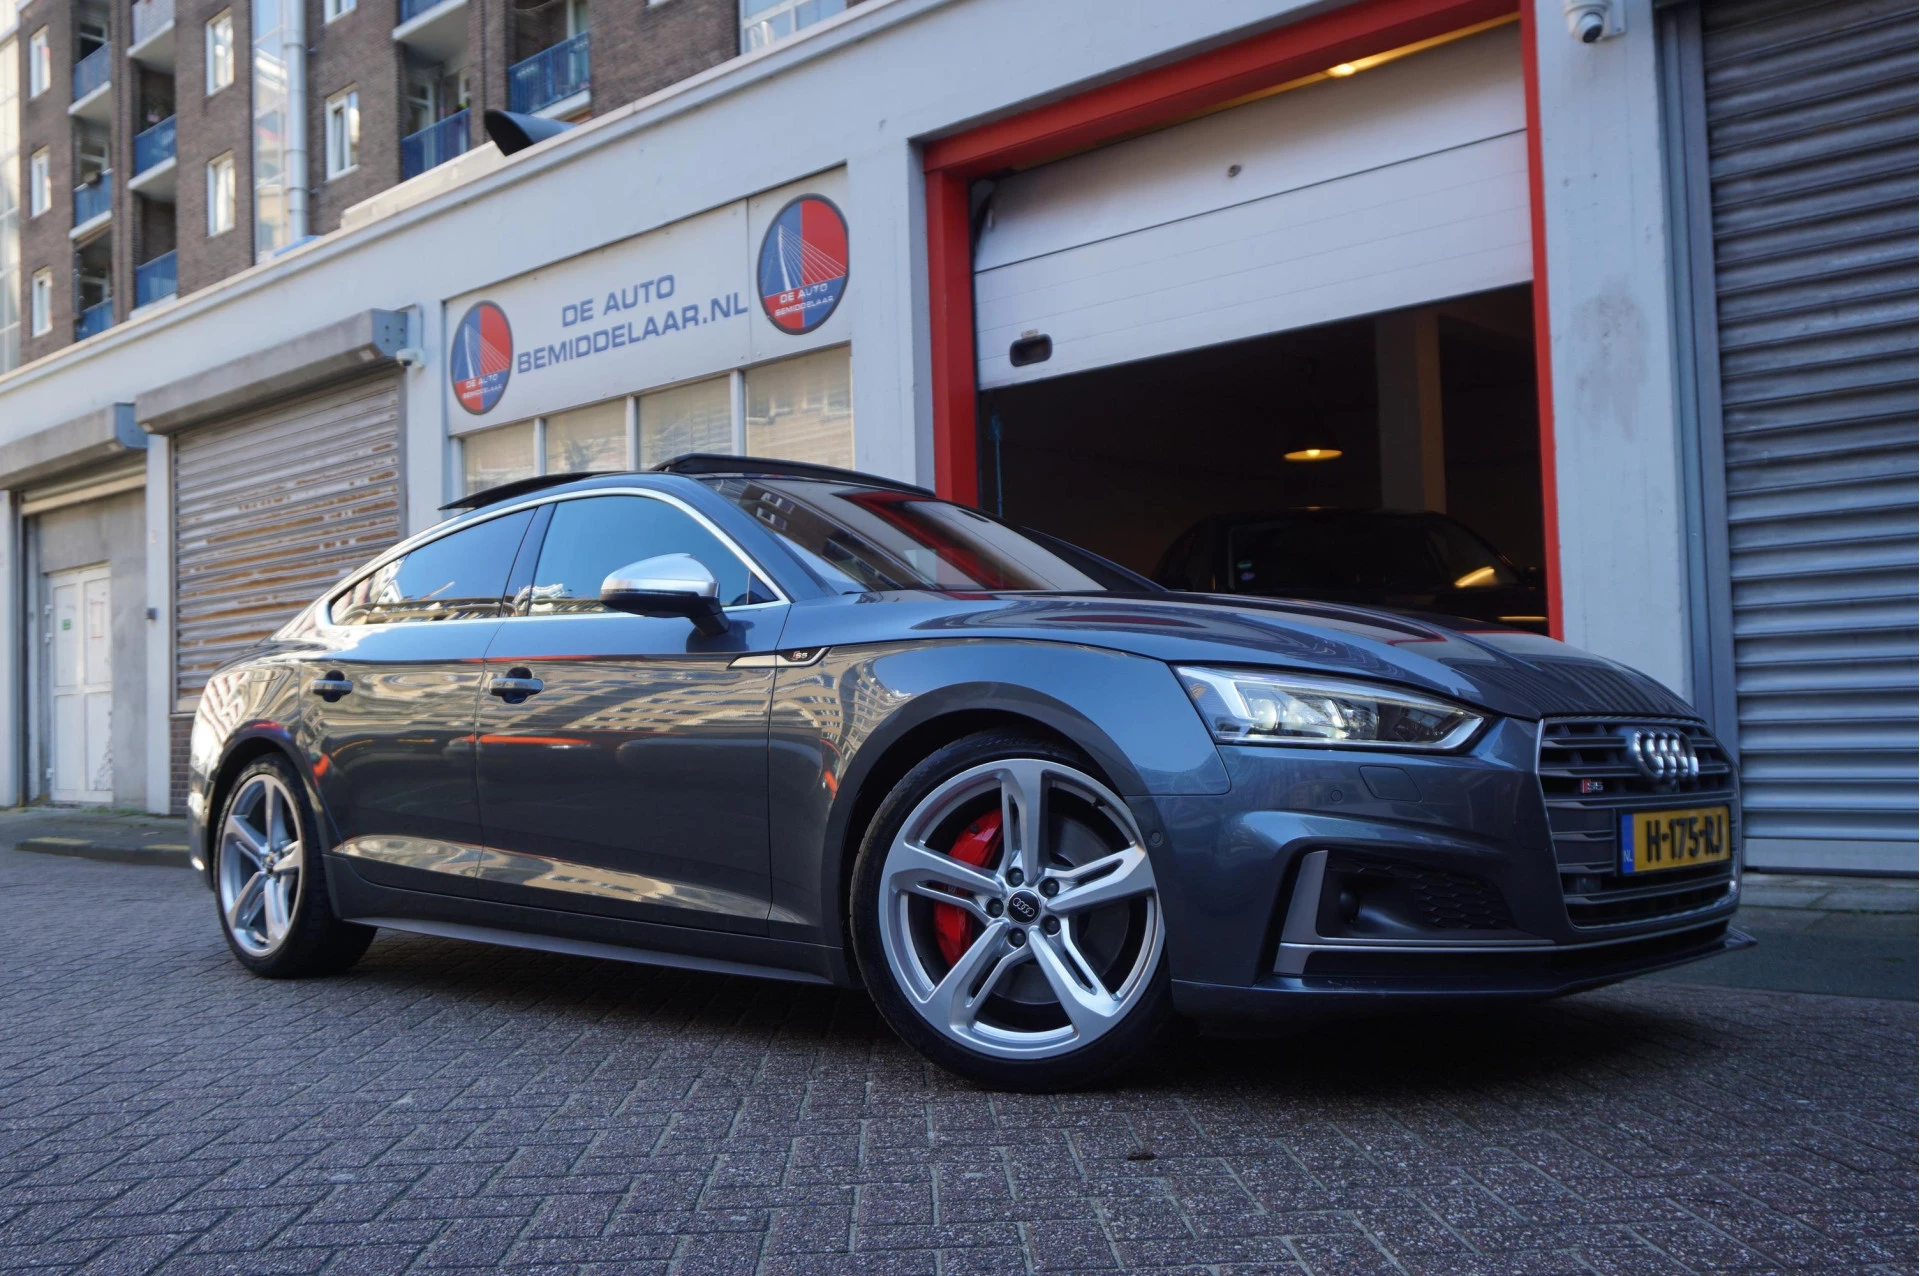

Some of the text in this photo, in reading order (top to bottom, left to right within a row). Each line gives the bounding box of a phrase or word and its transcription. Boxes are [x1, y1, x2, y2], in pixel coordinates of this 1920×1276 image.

[561, 273, 675, 328] DE AUTO
[779, 282, 829, 304] DE AUTO
[774, 295, 835, 317] BEMIDDELAAR
[517, 291, 749, 374] BEMIDDELAAR.NL
[465, 379, 477, 389] DE
[1645, 814, 1723, 863] H-175-RJ
[1623, 849, 1633, 862] NL
